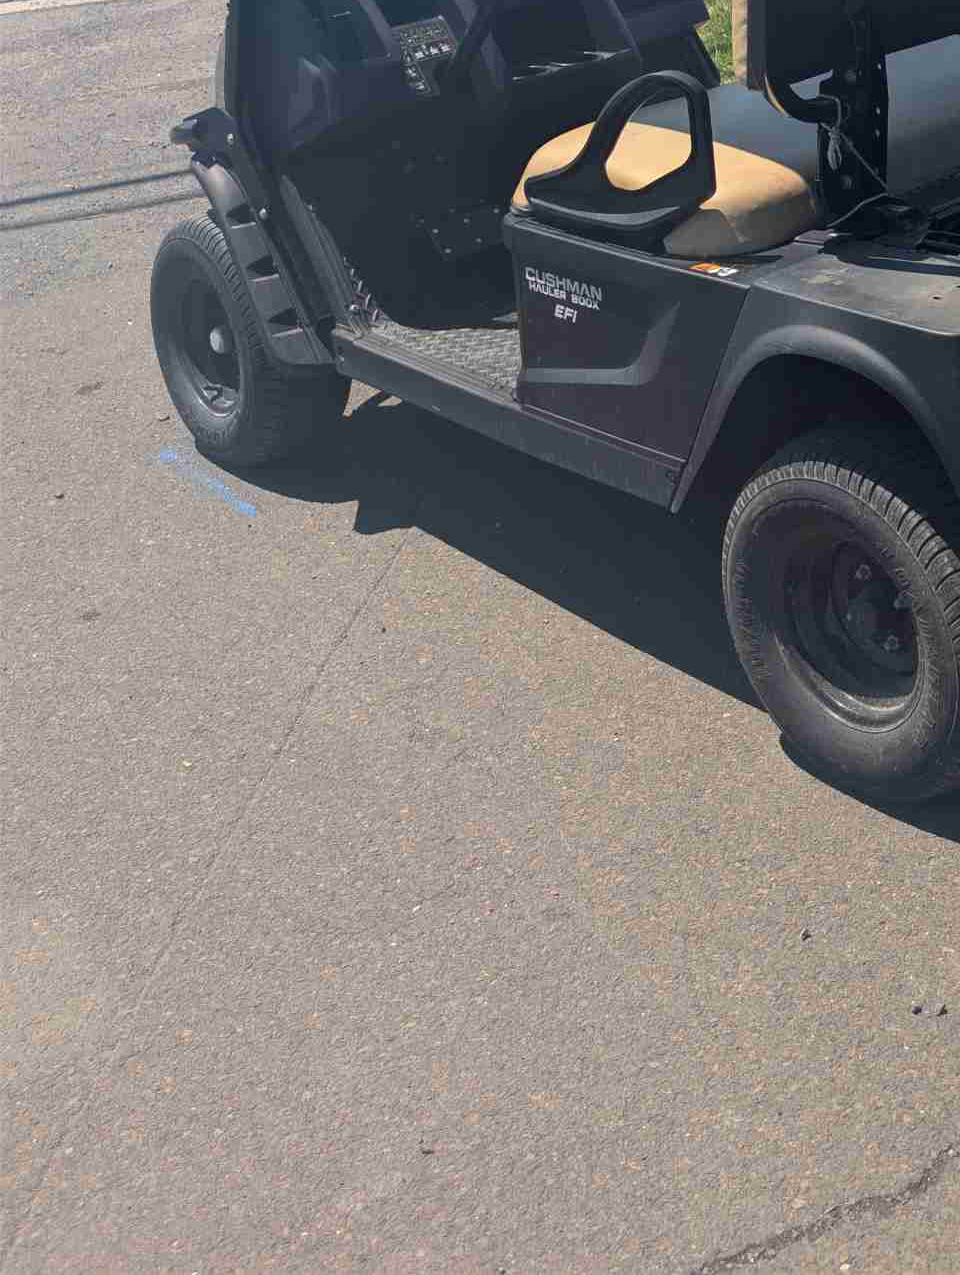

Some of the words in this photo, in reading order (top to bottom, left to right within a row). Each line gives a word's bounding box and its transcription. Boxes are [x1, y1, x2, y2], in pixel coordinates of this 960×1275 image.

[524, 266, 603, 302] CUSHMAN
[528, 280, 567, 301] HAULER
[554, 304, 578, 324] EFI
